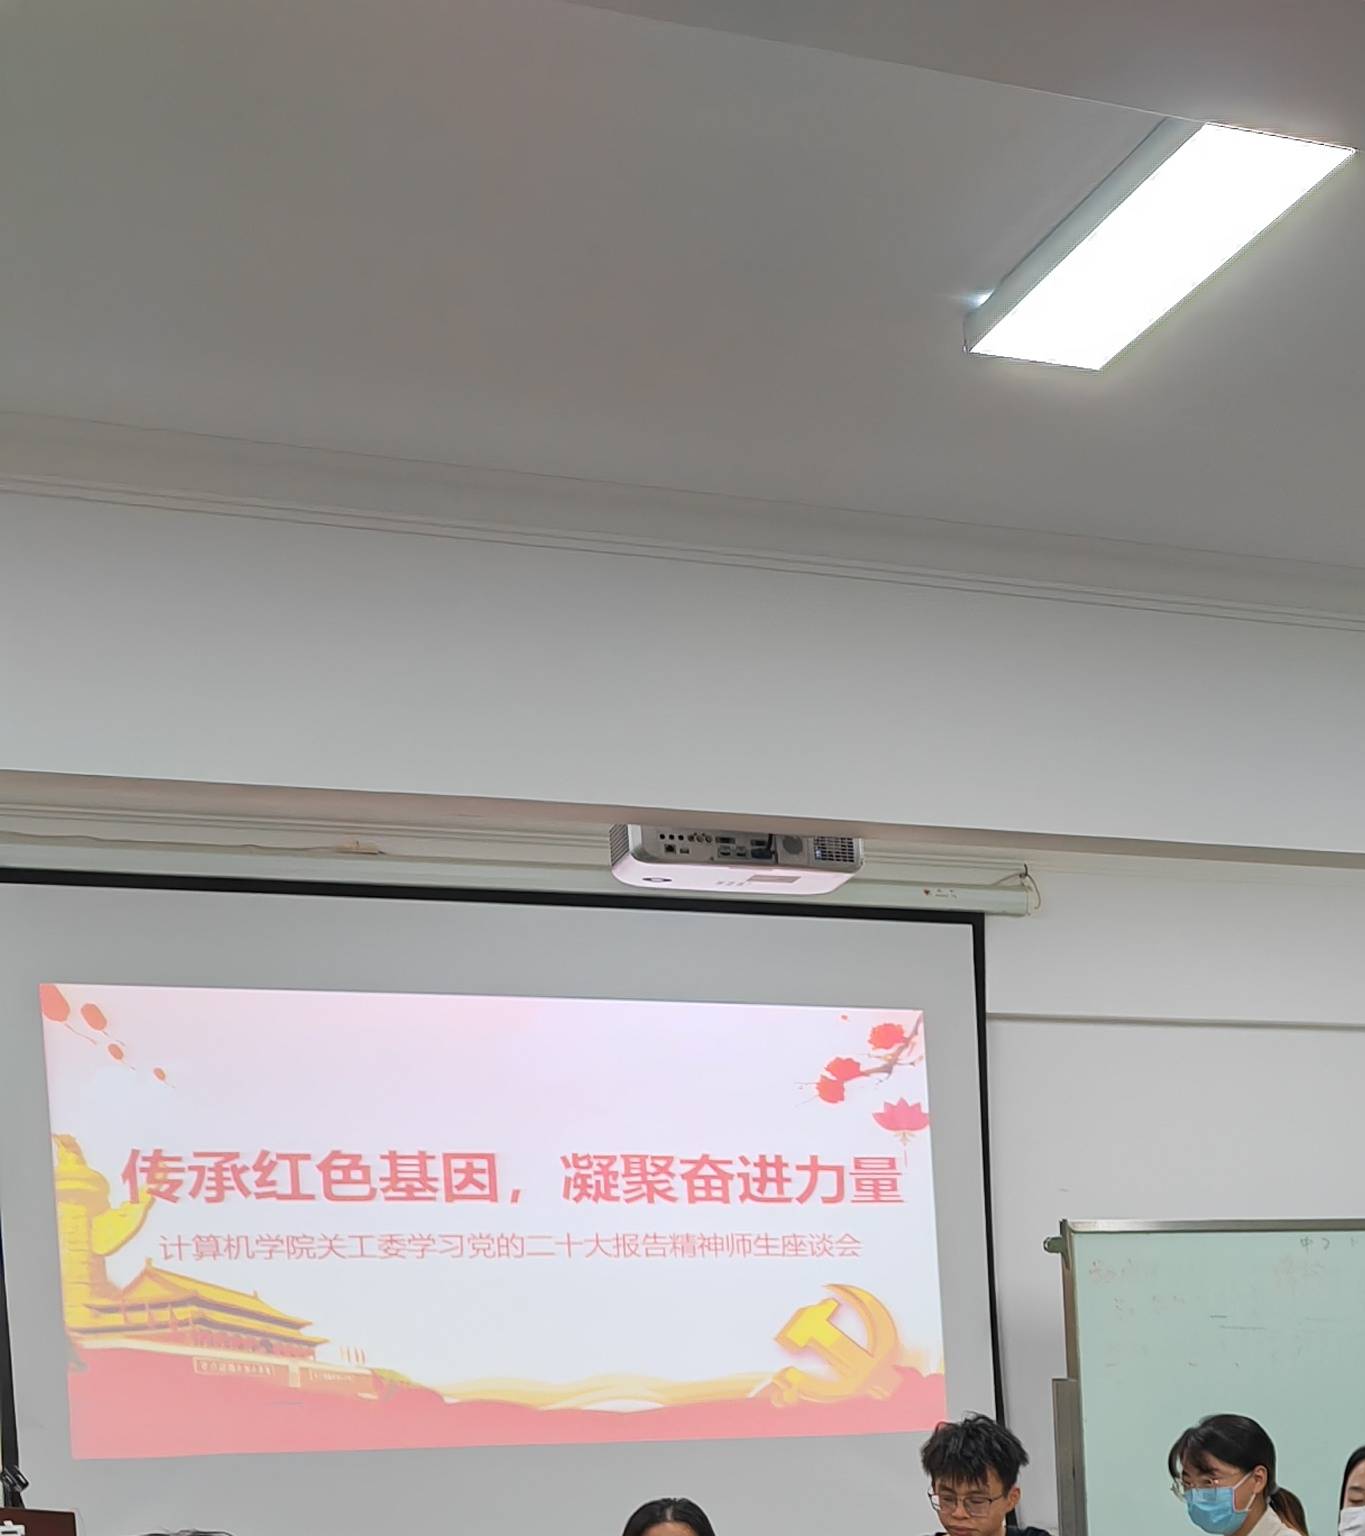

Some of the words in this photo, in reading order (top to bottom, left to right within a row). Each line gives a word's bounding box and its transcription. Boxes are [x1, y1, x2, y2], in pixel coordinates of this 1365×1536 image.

[158, 1232, 863, 1262] 计算机学院关工委学习党的二十大报告精神师生座谈会
